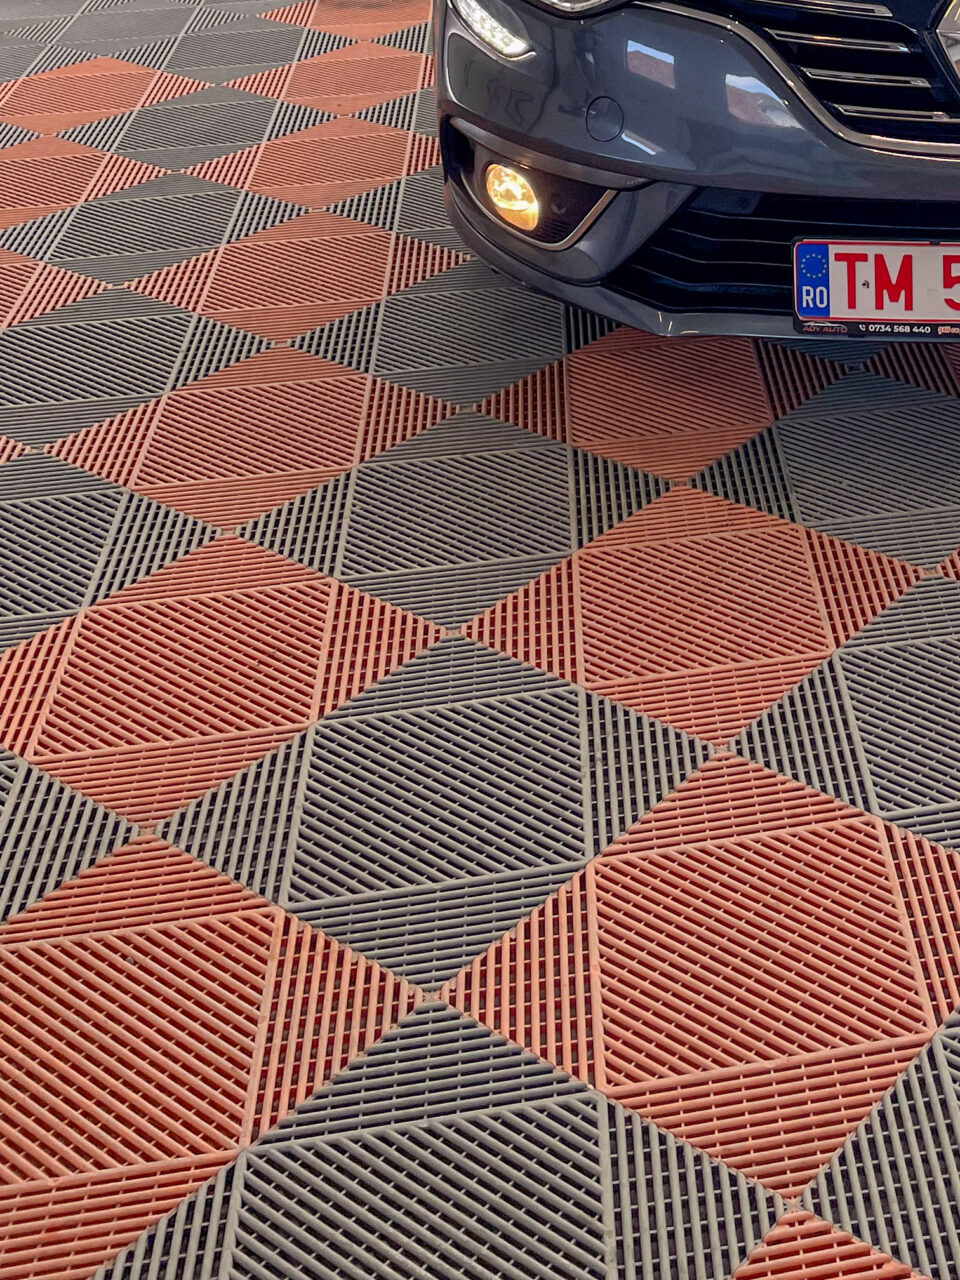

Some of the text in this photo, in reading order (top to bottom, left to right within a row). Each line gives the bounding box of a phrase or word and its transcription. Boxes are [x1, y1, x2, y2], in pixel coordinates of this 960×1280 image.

[834, 252, 913, 311] TM
[802, 285, 828, 308] RO
[868, 323, 892, 332] 0734
[893, 324, 911, 333] 568
[912, 325, 931, 334] 440
